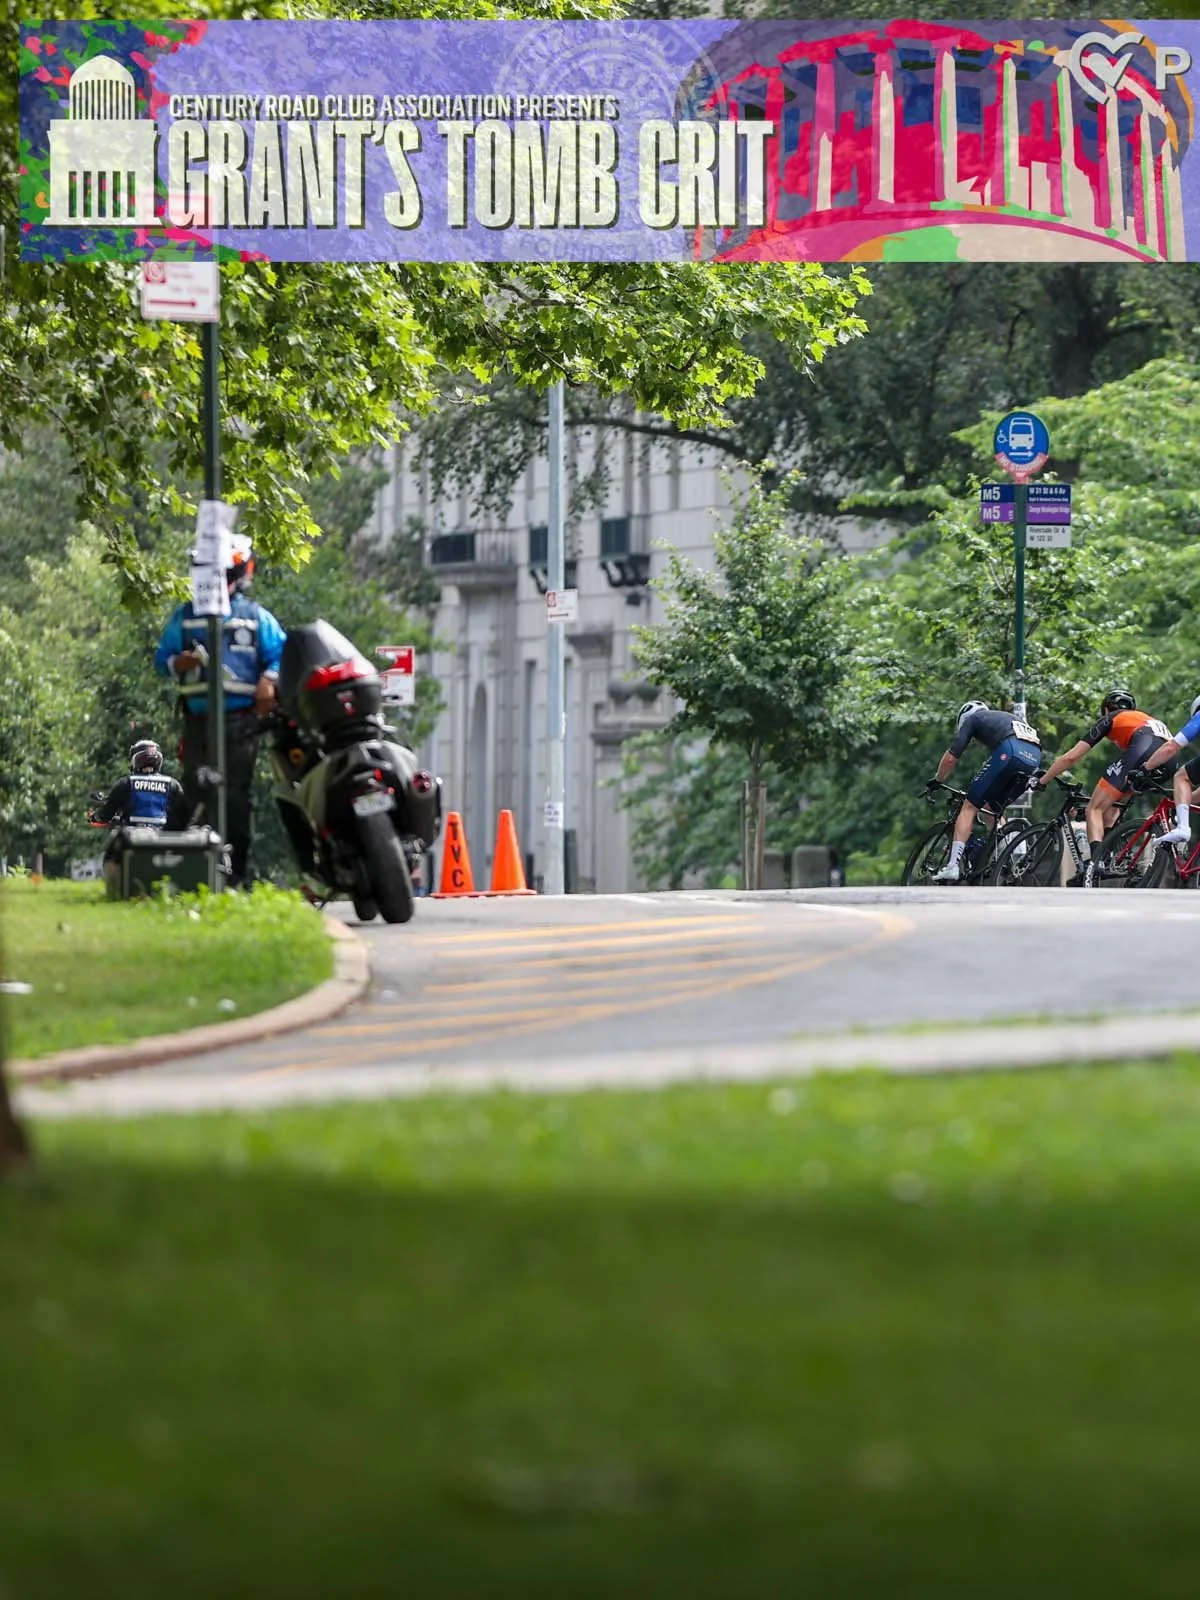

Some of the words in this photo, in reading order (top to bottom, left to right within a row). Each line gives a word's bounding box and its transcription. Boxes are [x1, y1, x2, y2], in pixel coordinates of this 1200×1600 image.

[982, 486, 1001, 501] M5
[982, 505, 1001, 520] M5
[134, 780, 167, 793] OFFICIAL
